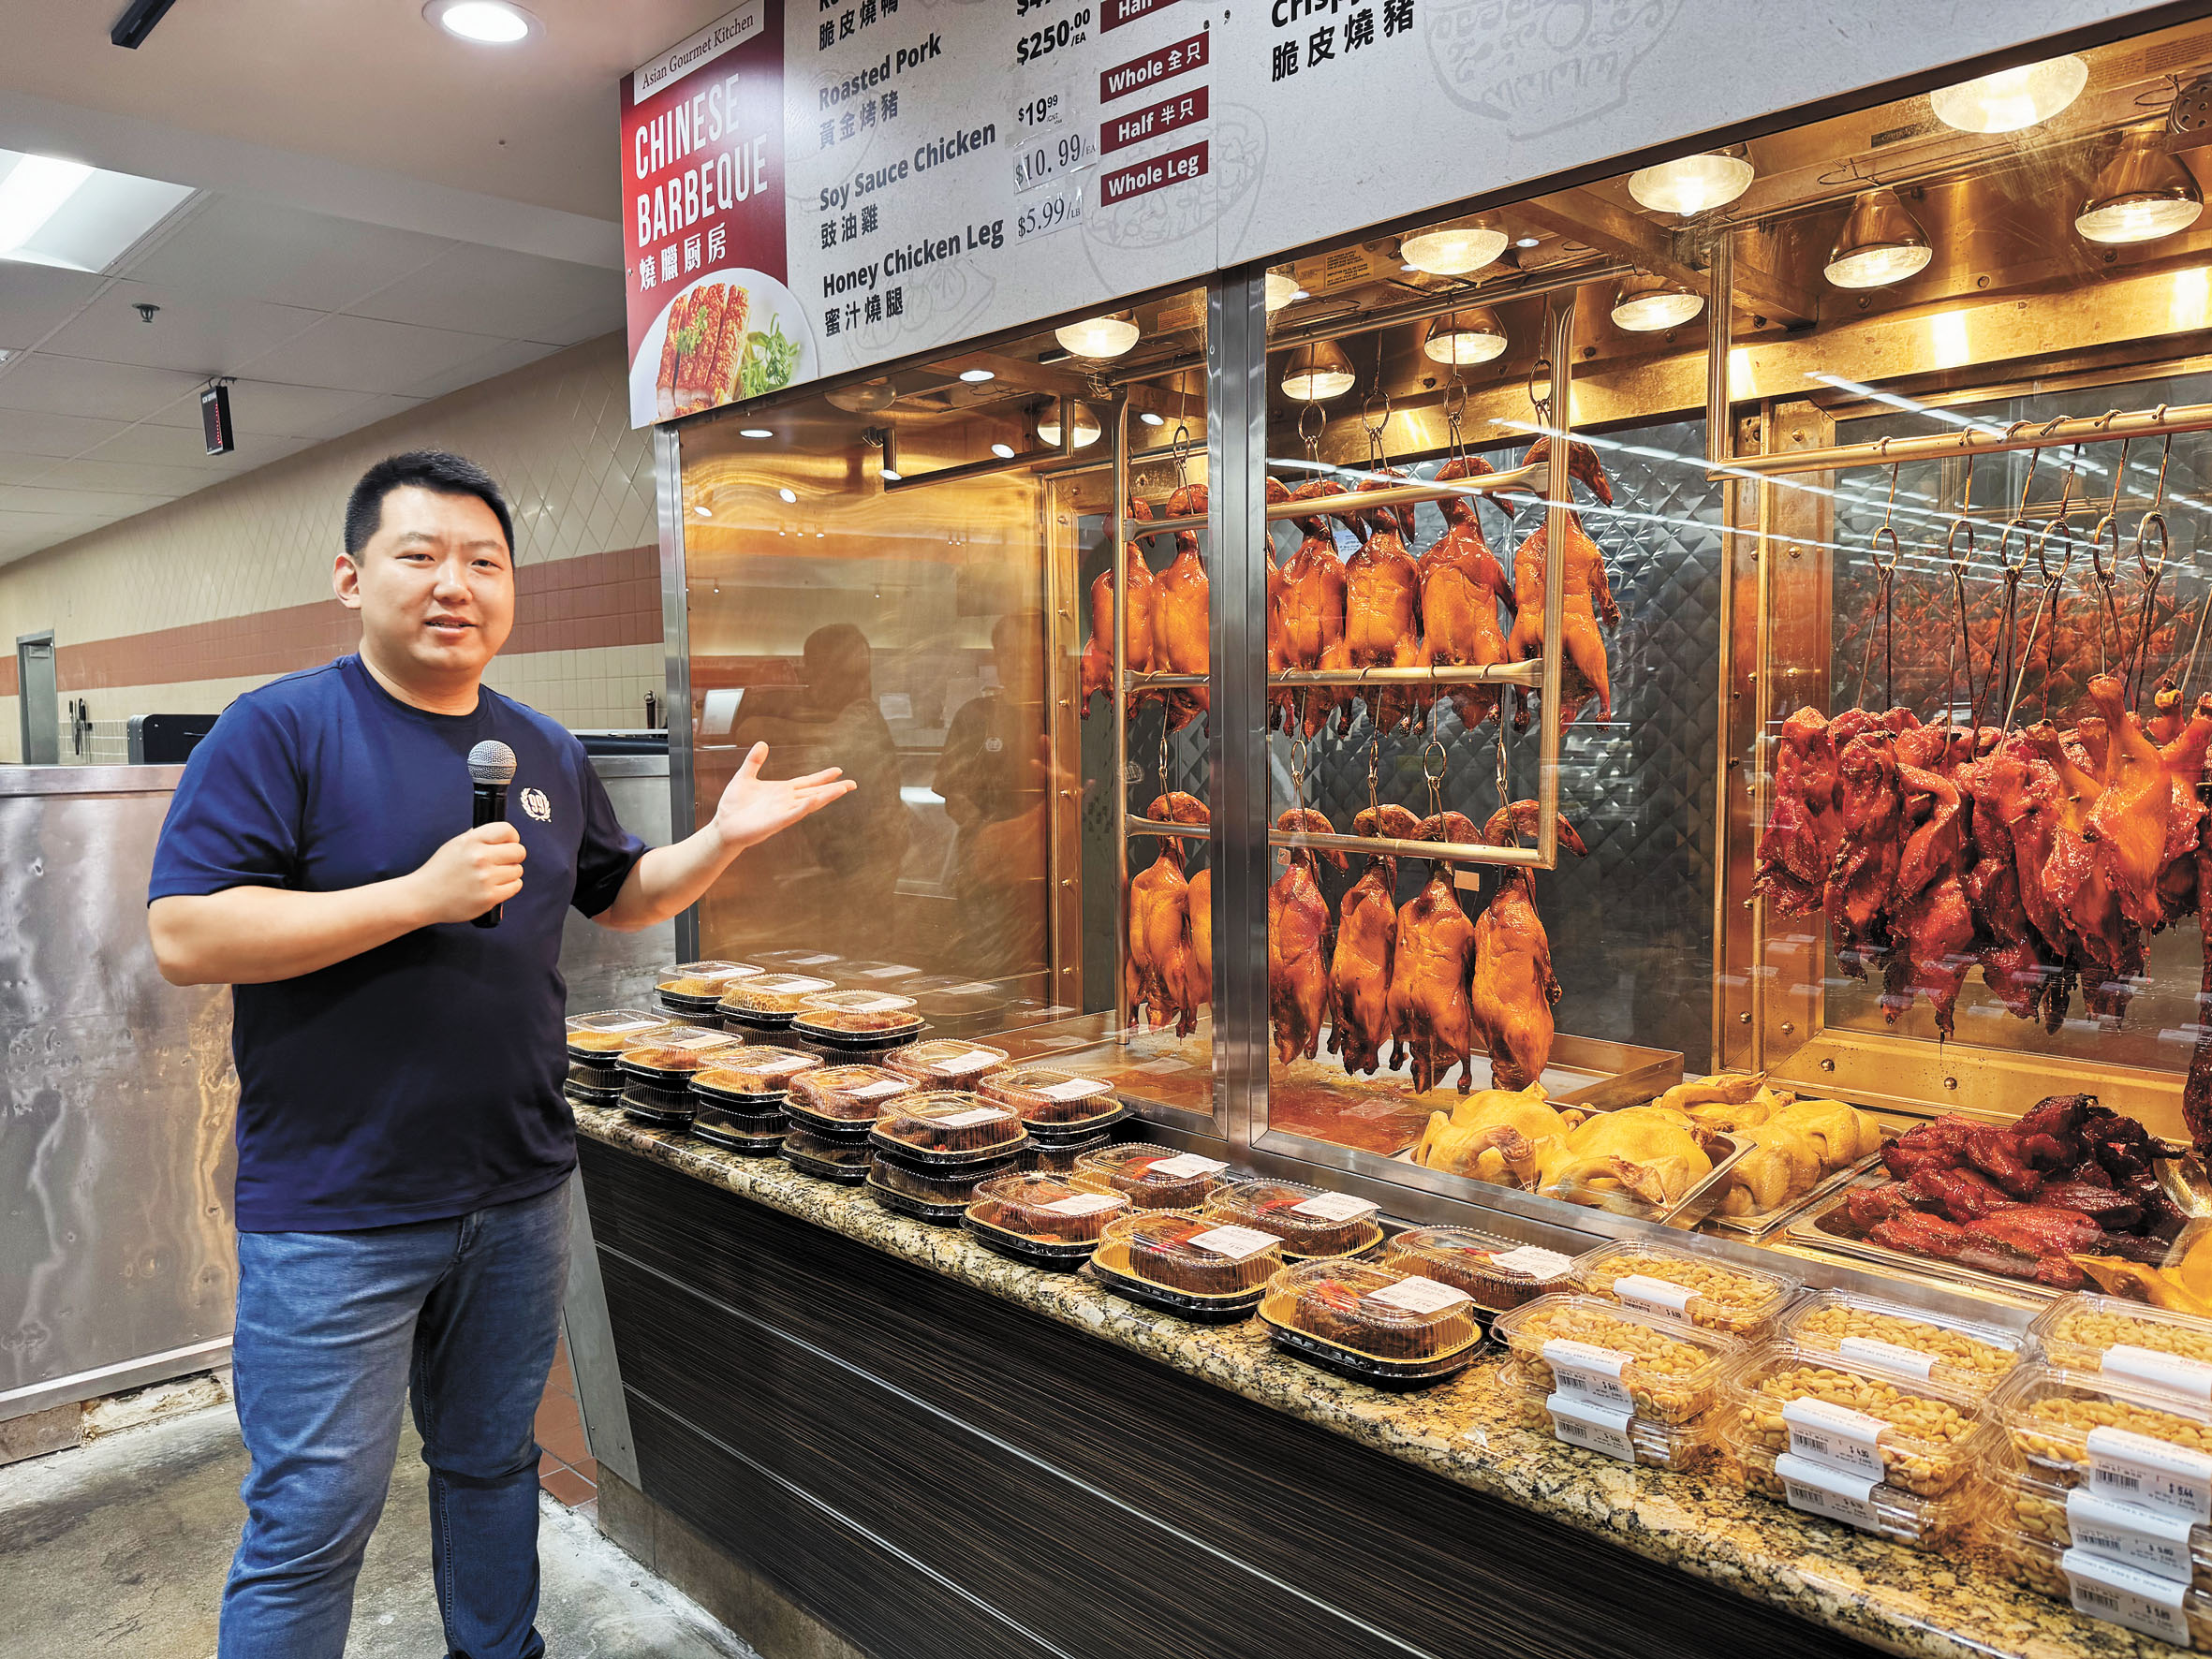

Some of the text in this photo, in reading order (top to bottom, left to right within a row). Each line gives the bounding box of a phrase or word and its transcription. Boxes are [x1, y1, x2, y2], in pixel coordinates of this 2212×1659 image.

[641, 14, 754, 90] Asian Gourmet Kitchen
[818, 33, 942, 111] Roasted Pork
[1108, 41, 1202, 94] Whole 全只
[1272, 0, 1415, 82] 脆皮燒豬
[635, 73, 739, 180] CHINESE
[1118, 97, 1194, 142] Half 半只
[637, 134, 768, 248] BARBEQUE
[820, 123, 995, 212] Soy Sauce Chicken
[1108, 154, 1200, 198] Whole Leg
[821, 203, 878, 250] 豉油雞
[823, 219, 1004, 299] Honey Chicken Leg
[825, 286, 903, 338] 蜜汁燒腿
[527, 794, 546, 814] 99
